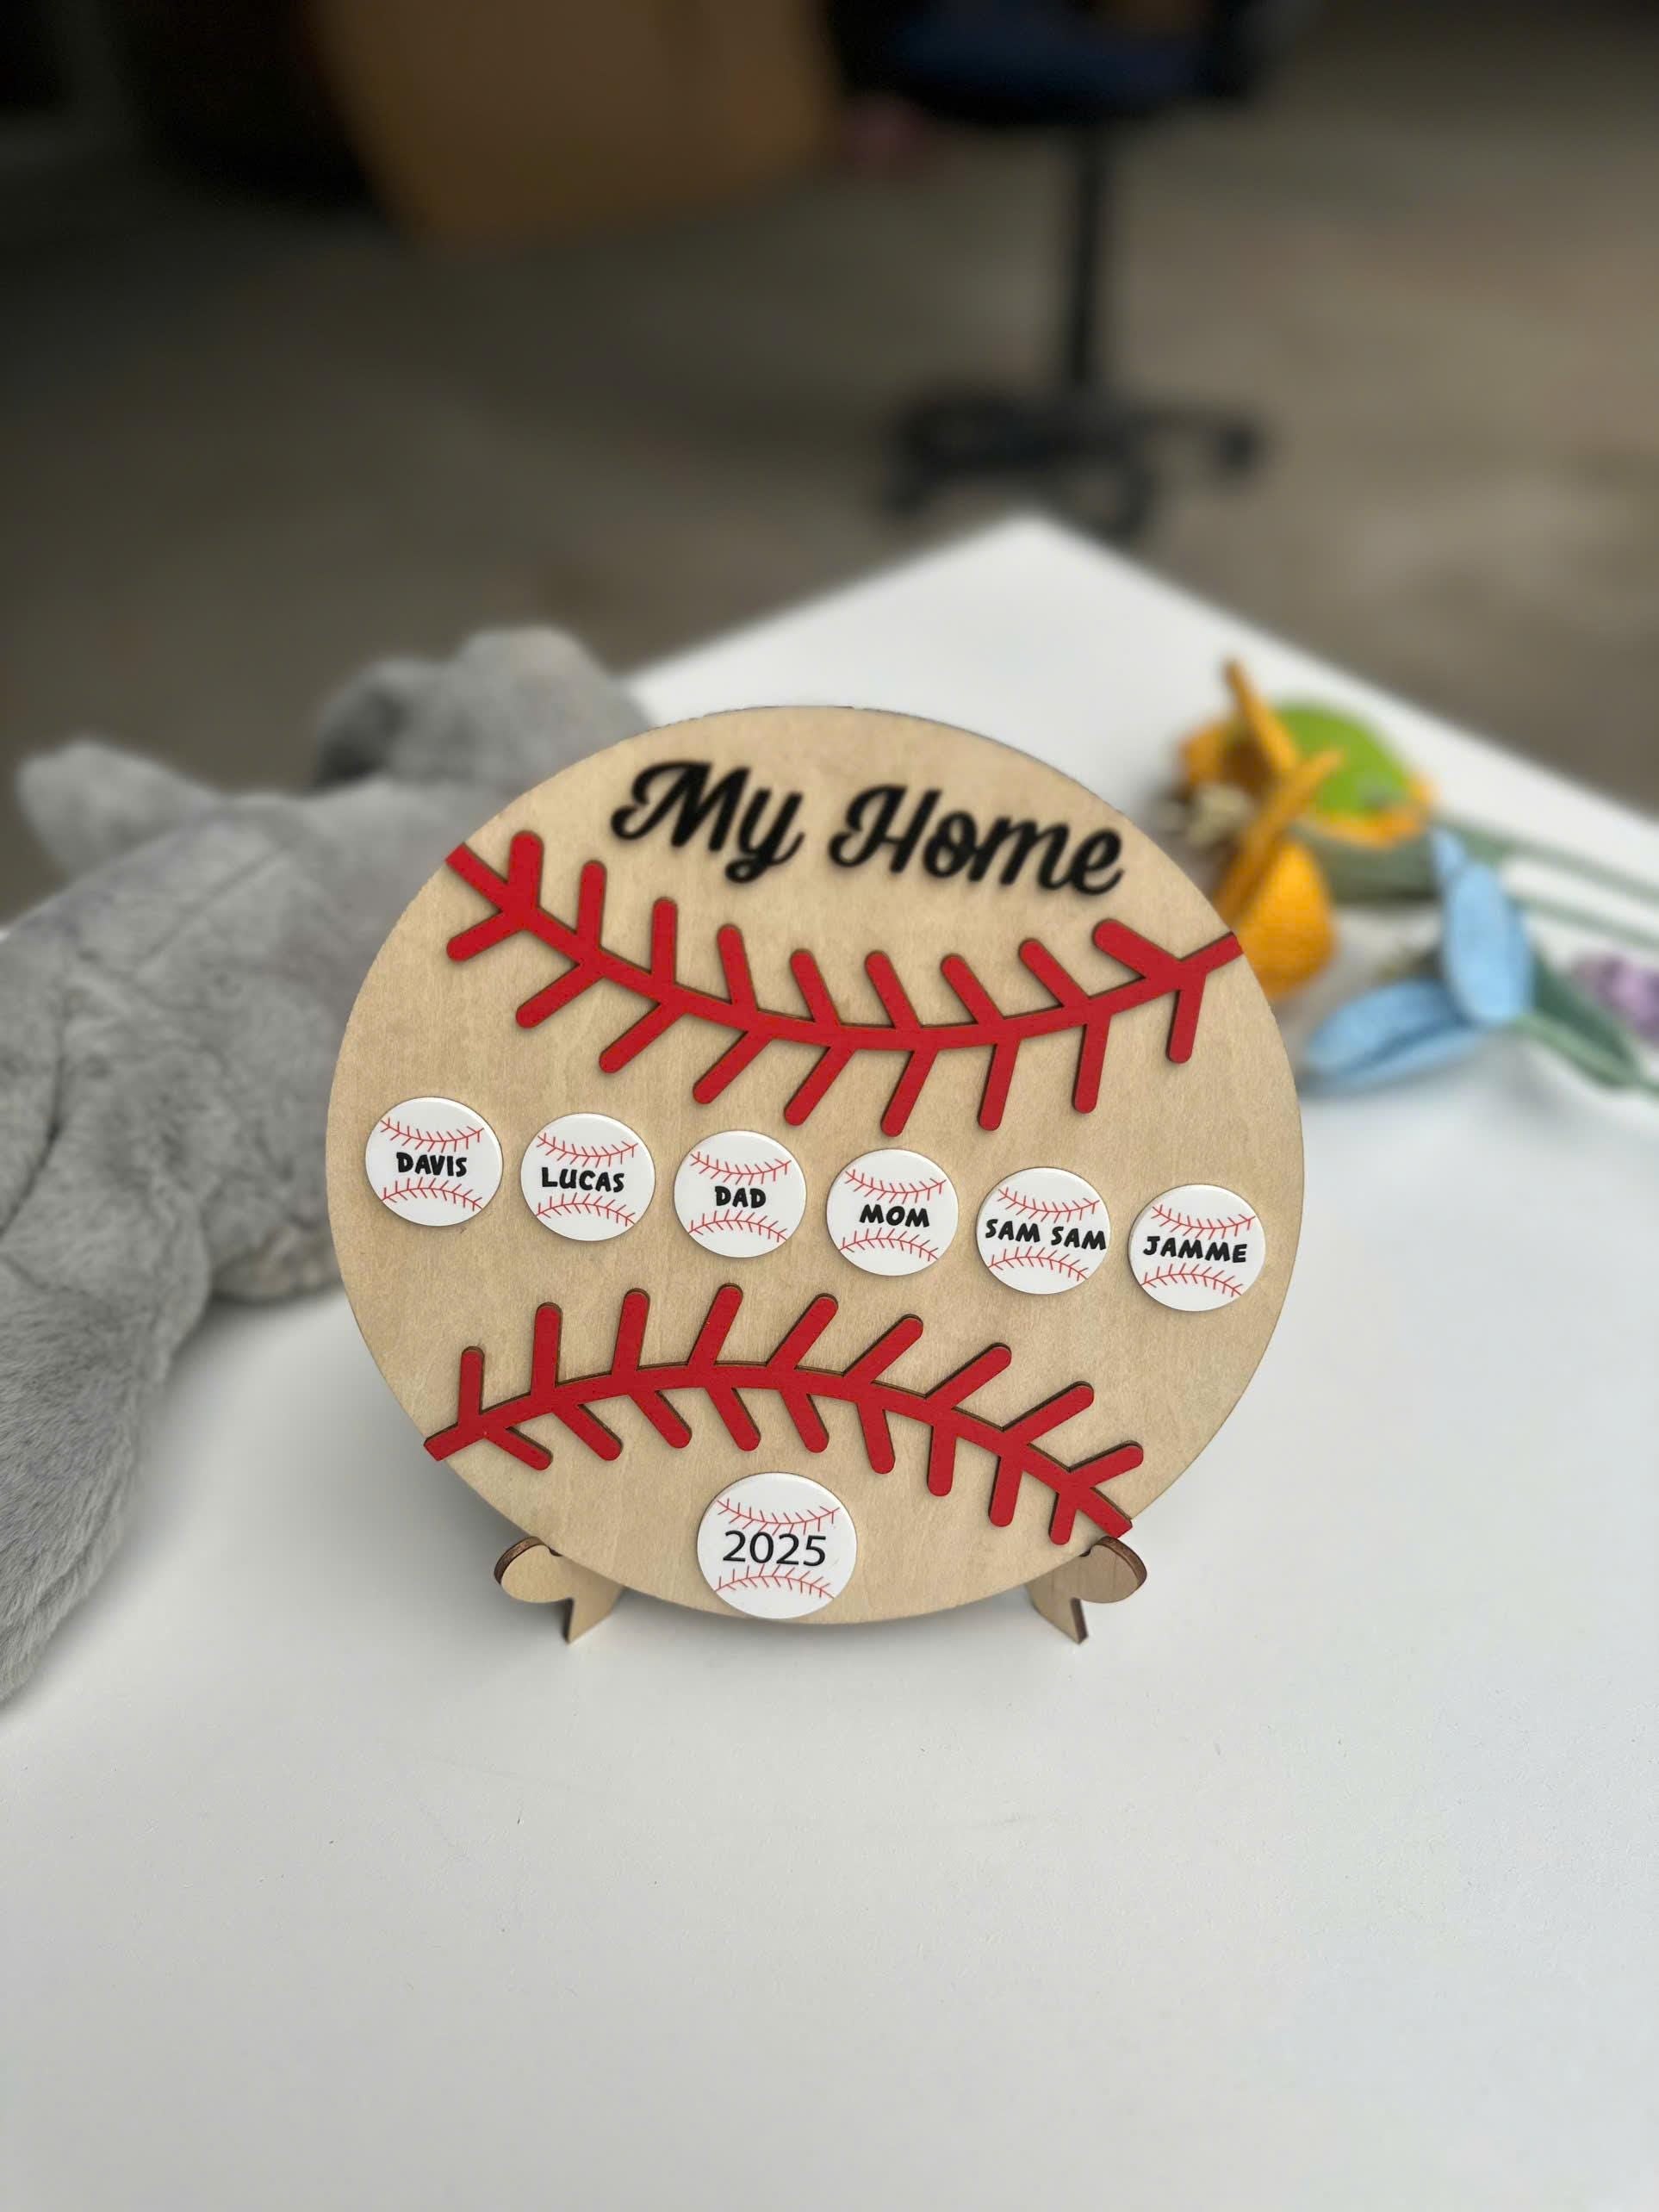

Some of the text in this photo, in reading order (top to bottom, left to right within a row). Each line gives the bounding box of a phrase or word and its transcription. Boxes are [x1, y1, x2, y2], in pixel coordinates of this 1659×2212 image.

[611, 761, 1123, 897] My Home
[395, 1152, 467, 1177] DAVIS
[541, 1166, 624, 1193] LUCAS
[714, 1185, 767, 1209] DAD
[859, 1204, 929, 1227] MOM
[985, 1219, 1107, 1251] SAM SAM
[1143, 1235, 1247, 1264] JAMME
[723, 1530, 826, 1567] 2025
